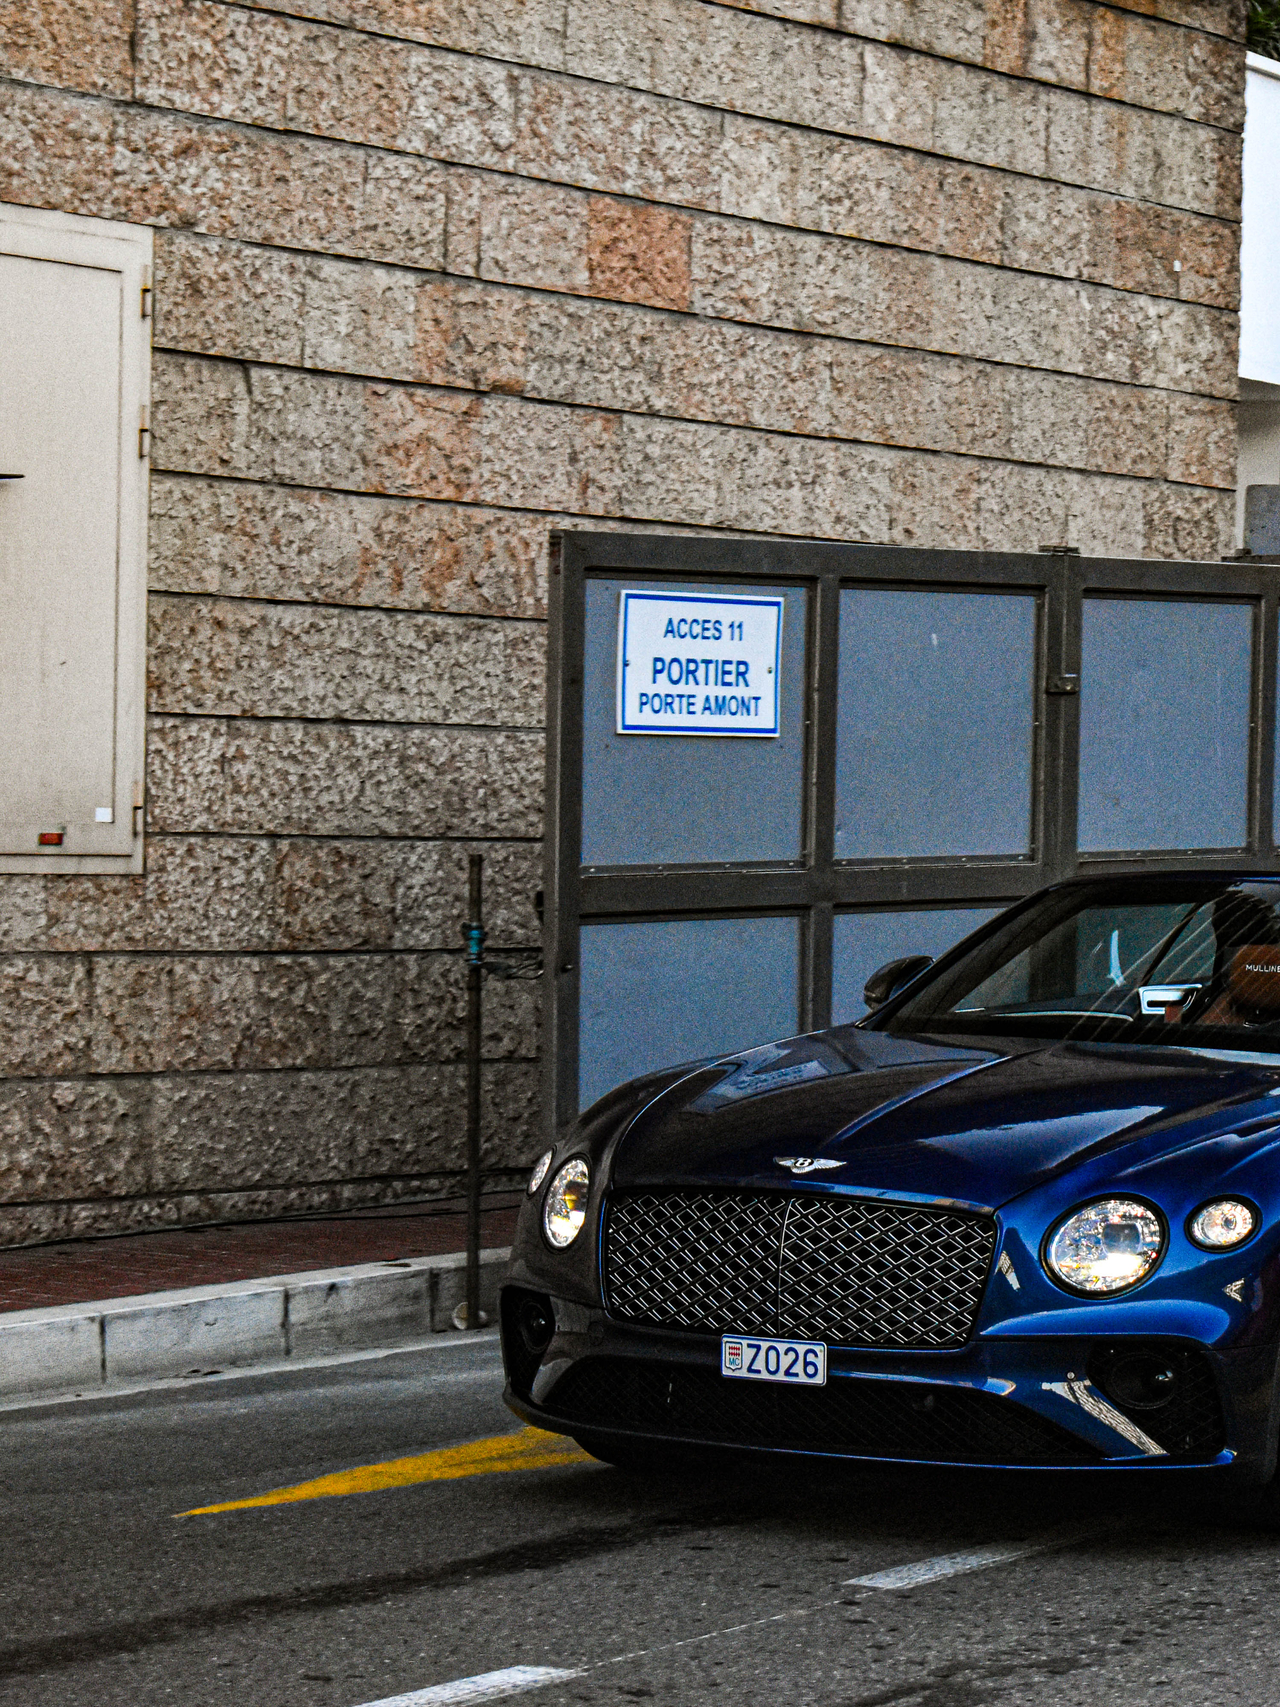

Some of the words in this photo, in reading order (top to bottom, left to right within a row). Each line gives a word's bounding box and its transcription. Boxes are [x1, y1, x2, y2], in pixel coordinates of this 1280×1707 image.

[663, 617, 722, 641] ACCES
[728, 620, 744, 642] 11
[652, 656, 750, 688] PORTIER
[639, 692, 697, 716] PORTE
[701, 694, 762, 717] AMONT
[728, 1356, 740, 1367] MC
[746, 1342, 819, 1379] Z026
